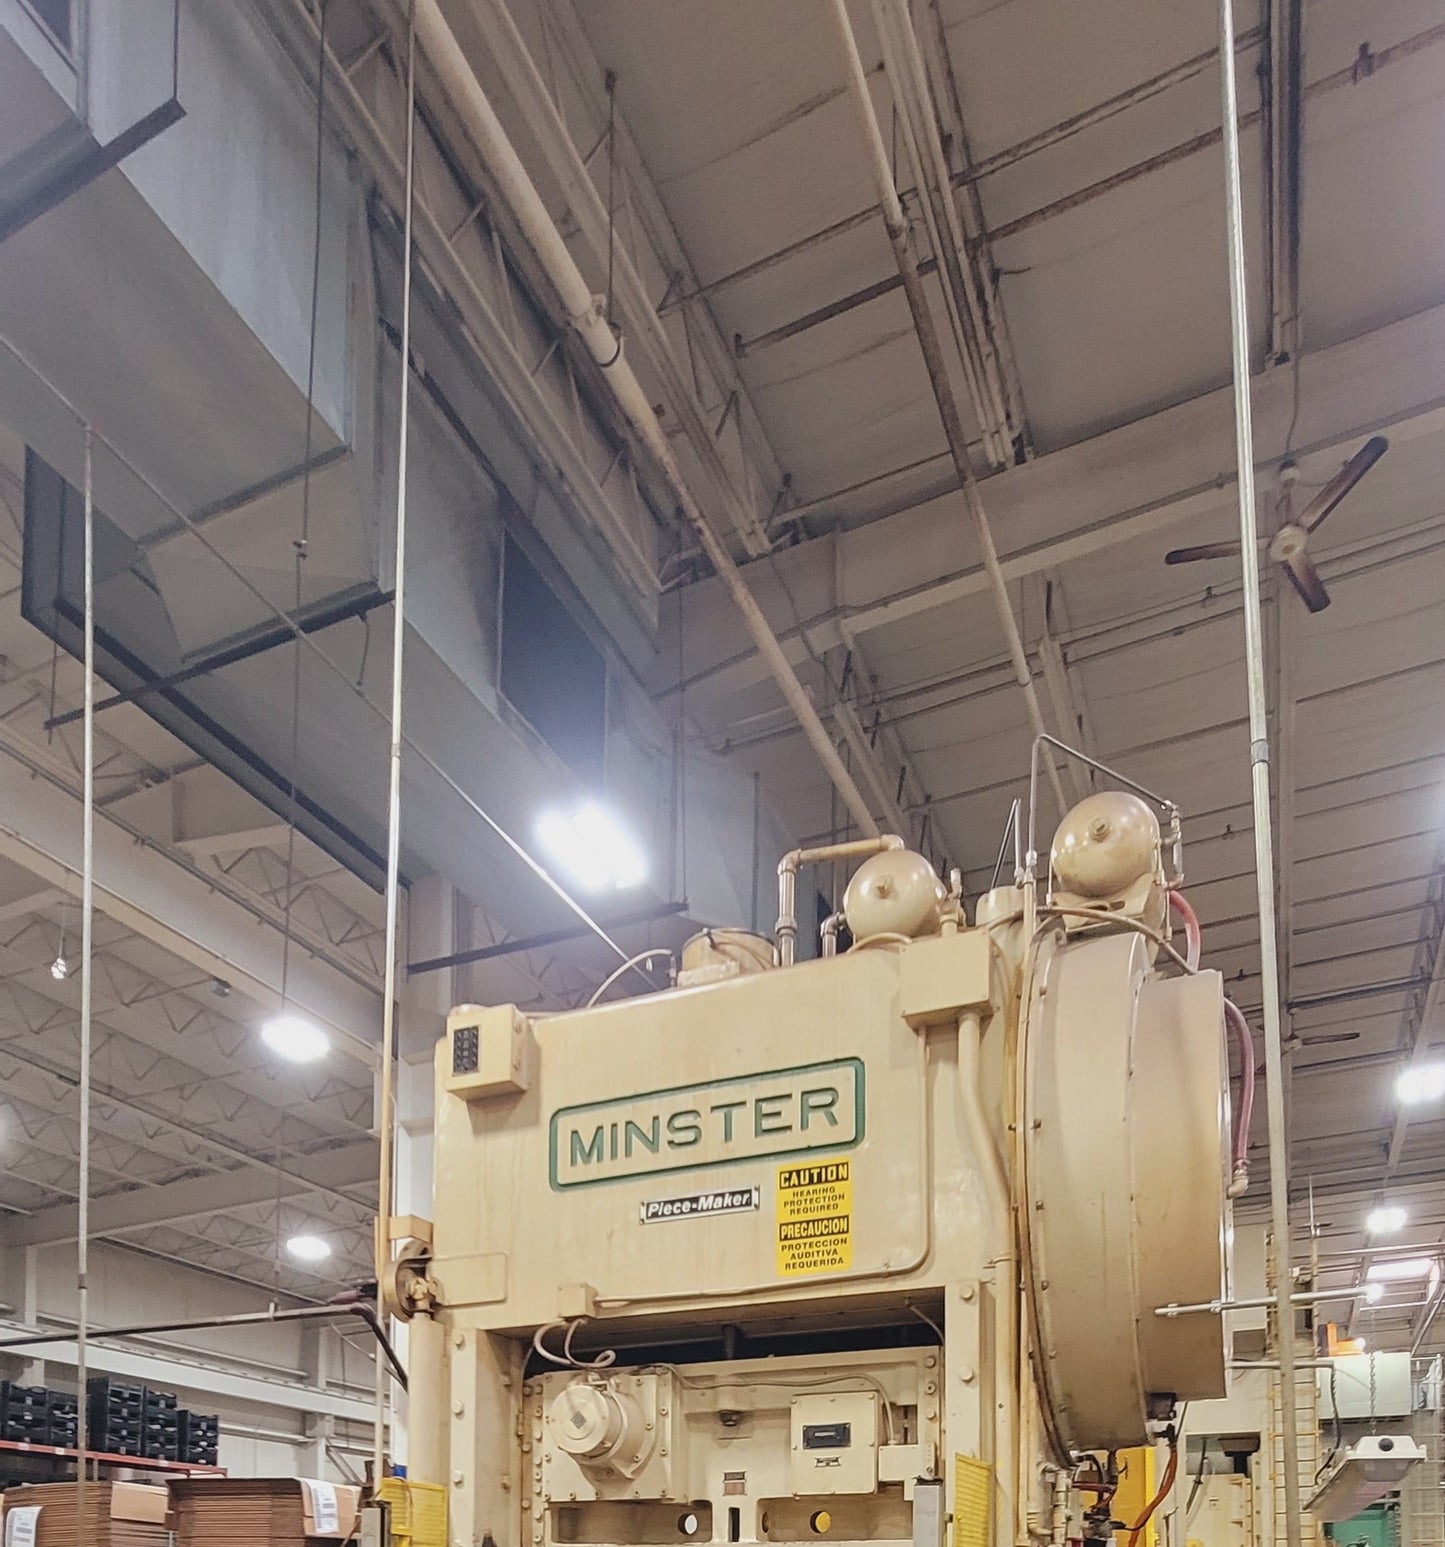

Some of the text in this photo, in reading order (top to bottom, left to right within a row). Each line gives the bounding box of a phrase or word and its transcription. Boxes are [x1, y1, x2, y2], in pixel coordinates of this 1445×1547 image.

[570, 1086, 840, 1168] MINSTER
[780, 1163, 848, 1188] CAUTION
[792, 1186, 836, 1198] HEARING
[647, 1192, 751, 1218] Piece-Maker
[783, 1193, 845, 1208] PROTECTION
[789, 1203, 839, 1216] REQUIRED
[780, 1217, 848, 1239] PRECAUCION
[781, 1237, 848, 1252] PROTECCION
[790, 1248, 838, 1260] AUDITIVA
[784, 1257, 844, 1271] REQUERIDA
